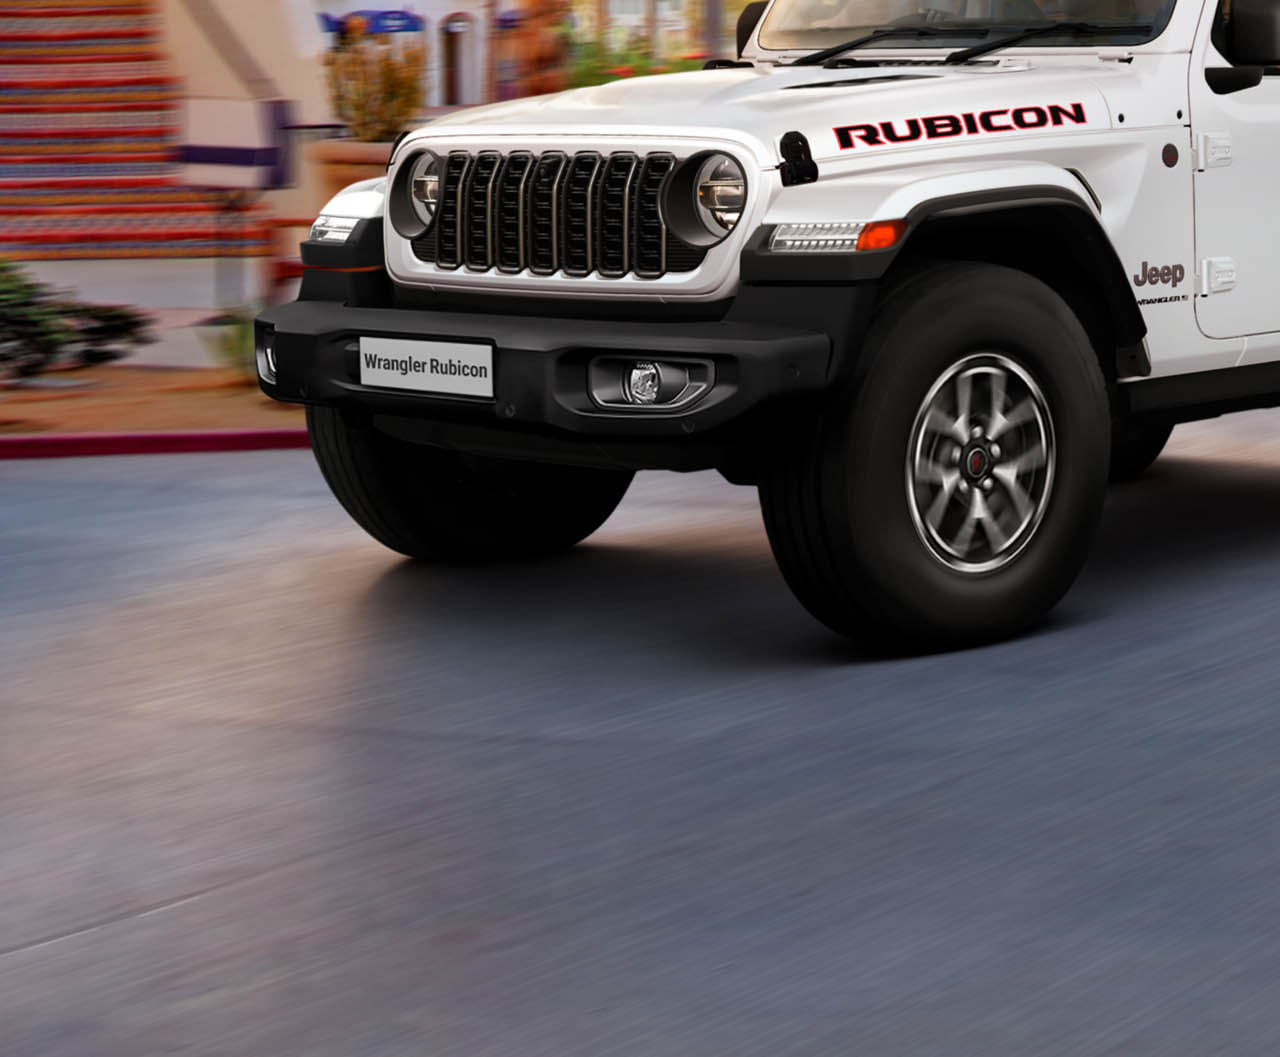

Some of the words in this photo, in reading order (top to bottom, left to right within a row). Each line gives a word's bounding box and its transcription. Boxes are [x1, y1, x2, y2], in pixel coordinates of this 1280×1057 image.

[832, 102, 1087, 150] RUBICON
[1133, 261, 1185, 288] Jeep
[364, 353, 427, 375] Wrangler
[430, 358, 488, 378] Rubicon
